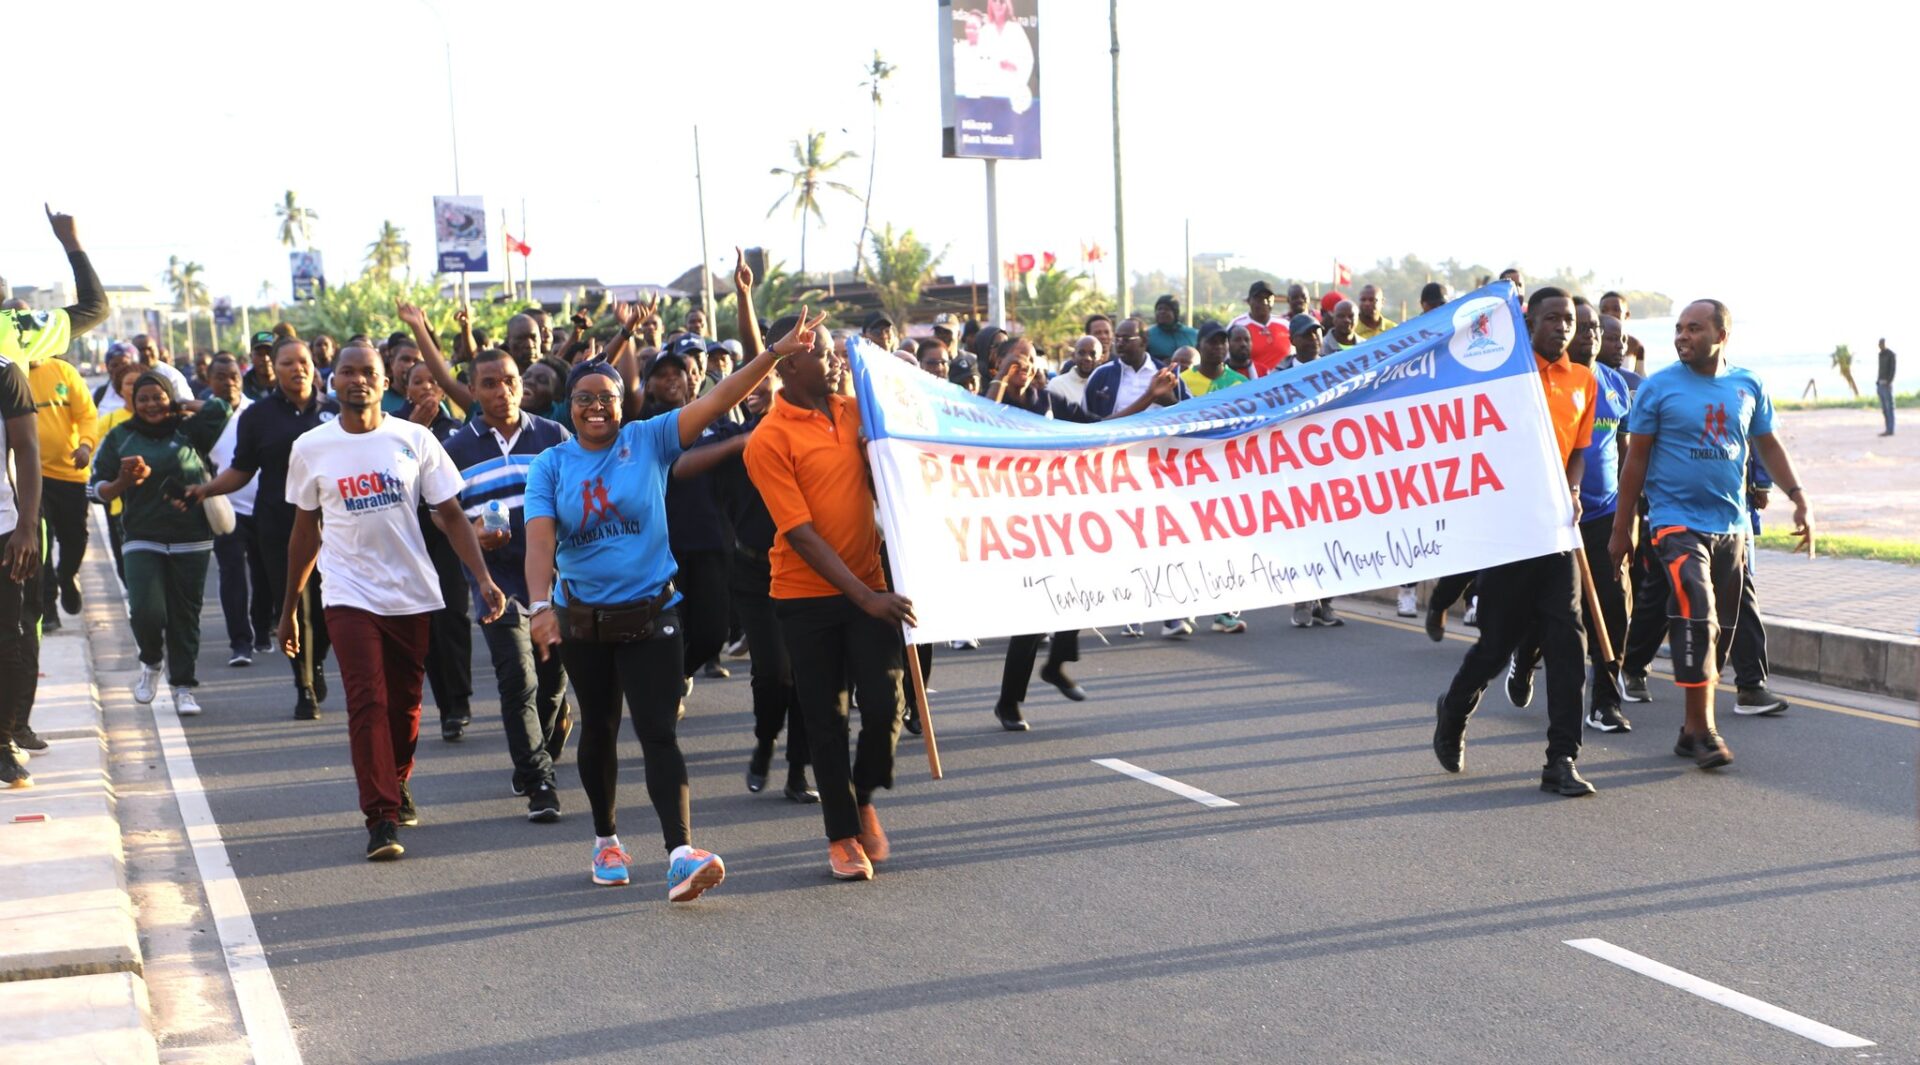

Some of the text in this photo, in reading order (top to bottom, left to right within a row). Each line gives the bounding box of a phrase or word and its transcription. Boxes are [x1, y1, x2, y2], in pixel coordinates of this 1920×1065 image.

[1254, 382, 1306, 410] WA
[918, 393, 1507, 498] PAMBANA NA MAGONJWA
[337, 472, 384, 499] FICO
[945, 452, 1505, 562] YASIYO YA KUAMBUKIZA
[604, 523, 619, 538] NA
[620, 519, 640, 535] JKCI
[1112, 584, 1131, 601] na
[1199, 559, 1246, 600] Linda
[1249, 553, 1299, 594] Afya
[1304, 561, 1324, 590] ya
[1324, 539, 1387, 581] Moyo
